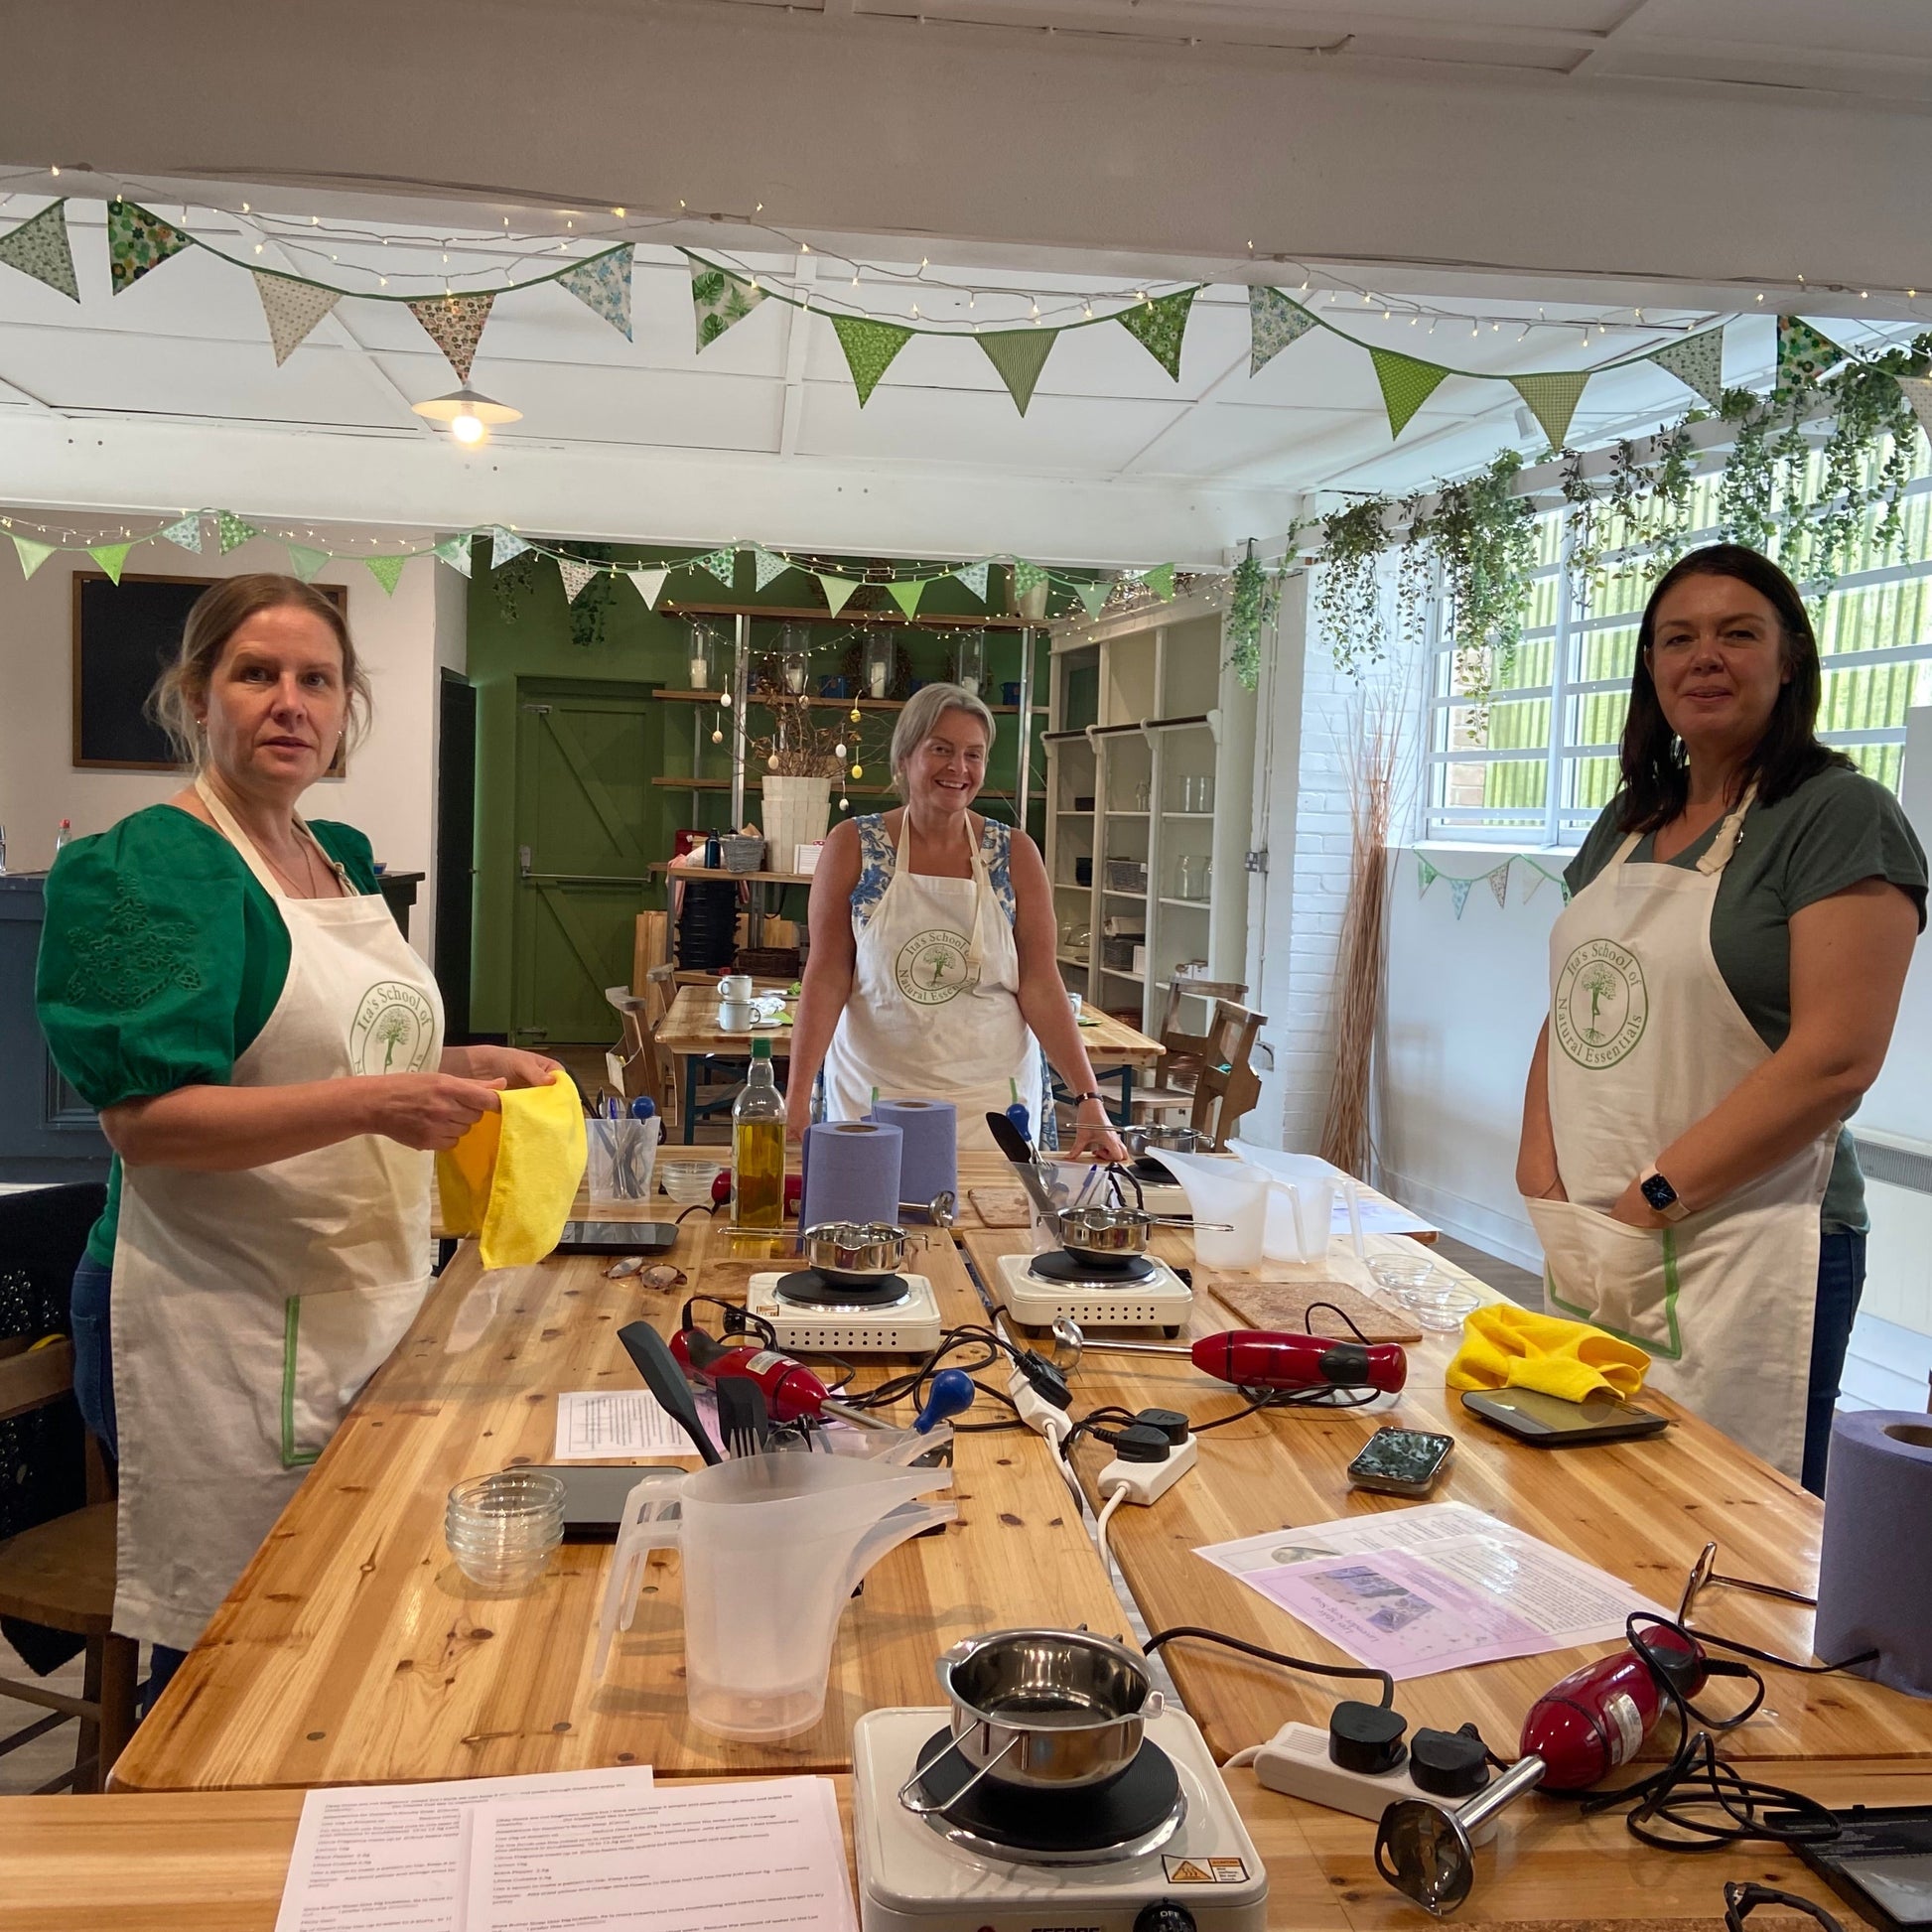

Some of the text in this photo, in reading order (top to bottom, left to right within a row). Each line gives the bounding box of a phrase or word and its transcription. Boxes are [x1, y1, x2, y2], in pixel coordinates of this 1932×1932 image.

[928, 932, 967, 950] School
[898, 969, 927, 1001] Natural
[1591, 942, 1634, 971] School
[1628, 972, 1642, 987] of
[376, 985, 421, 1011] School
[419, 1010, 433, 1027] of
[1558, 998, 1643, 1063] Natural Essentials
